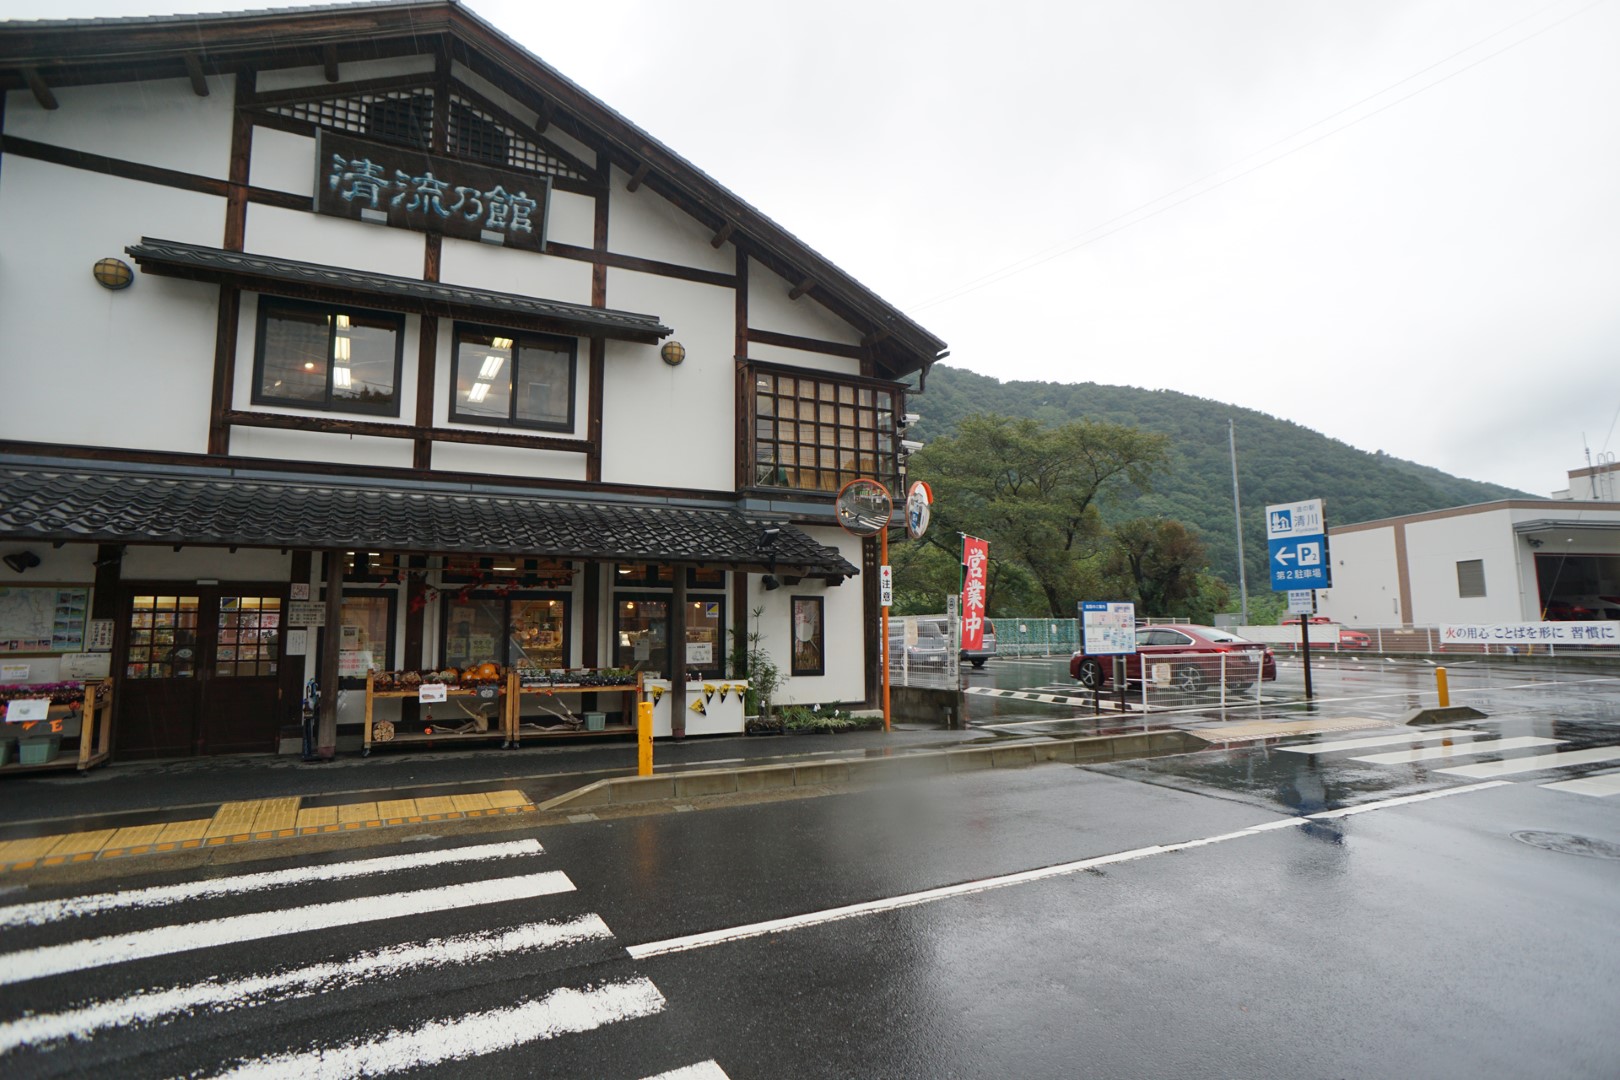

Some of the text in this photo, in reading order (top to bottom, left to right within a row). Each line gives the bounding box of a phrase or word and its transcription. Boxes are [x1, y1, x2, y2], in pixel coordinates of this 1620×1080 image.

[329, 154, 536, 233] 清流乃館
[1294, 513, 1318, 527] 清川
[1276, 568, 1321, 580] 第2駐車場
[882, 579, 891, 602] 注意
[965, 547, 986, 642] 営業中
[1445, 626, 1615, 640] 火の用心 ことばを形に 習慣に
